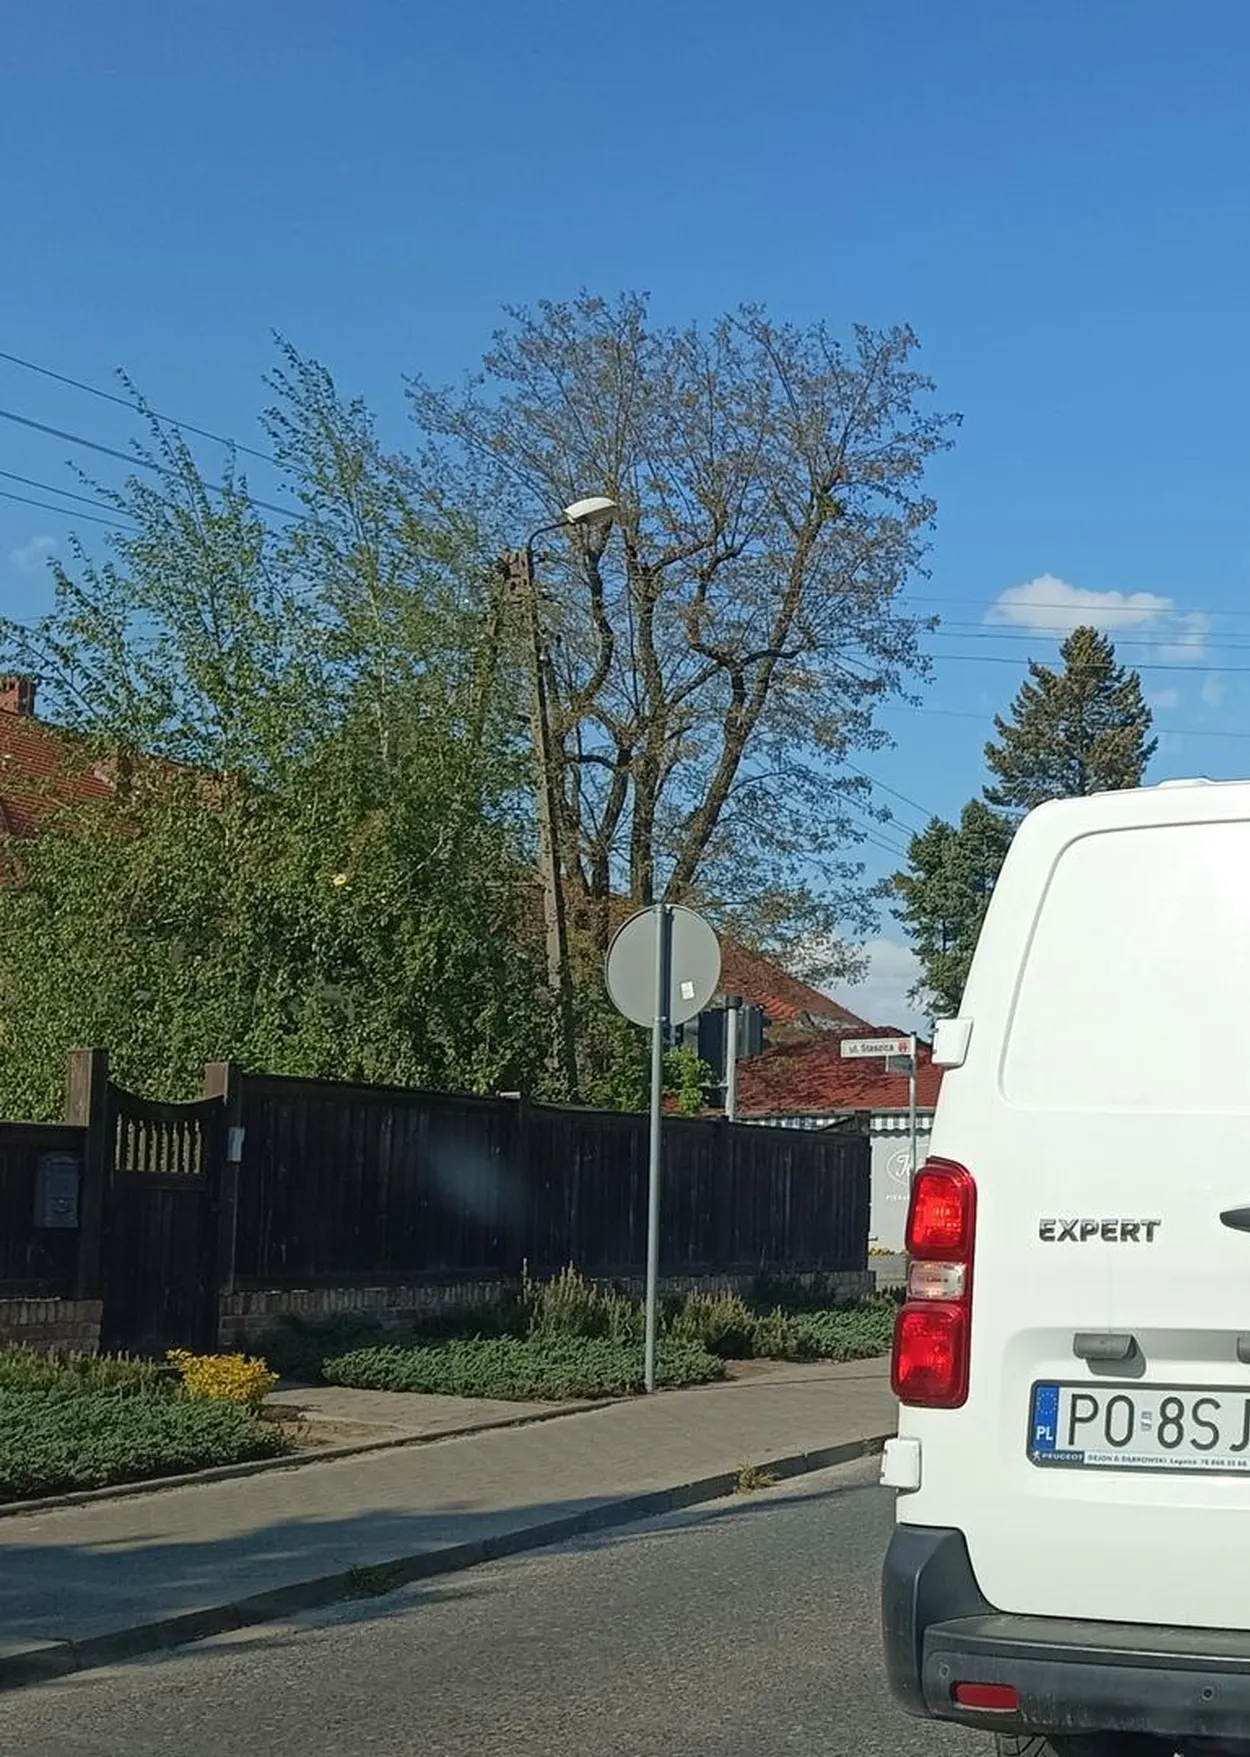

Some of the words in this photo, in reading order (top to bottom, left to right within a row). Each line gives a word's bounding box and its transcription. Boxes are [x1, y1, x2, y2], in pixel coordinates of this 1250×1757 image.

[1039, 1218, 1161, 1242] EXPERT
[1068, 1393, 1135, 1447] PO
[1035, 1426, 1054, 1441] PL
[1040, 1452, 1083, 1461] PEUGEOT
